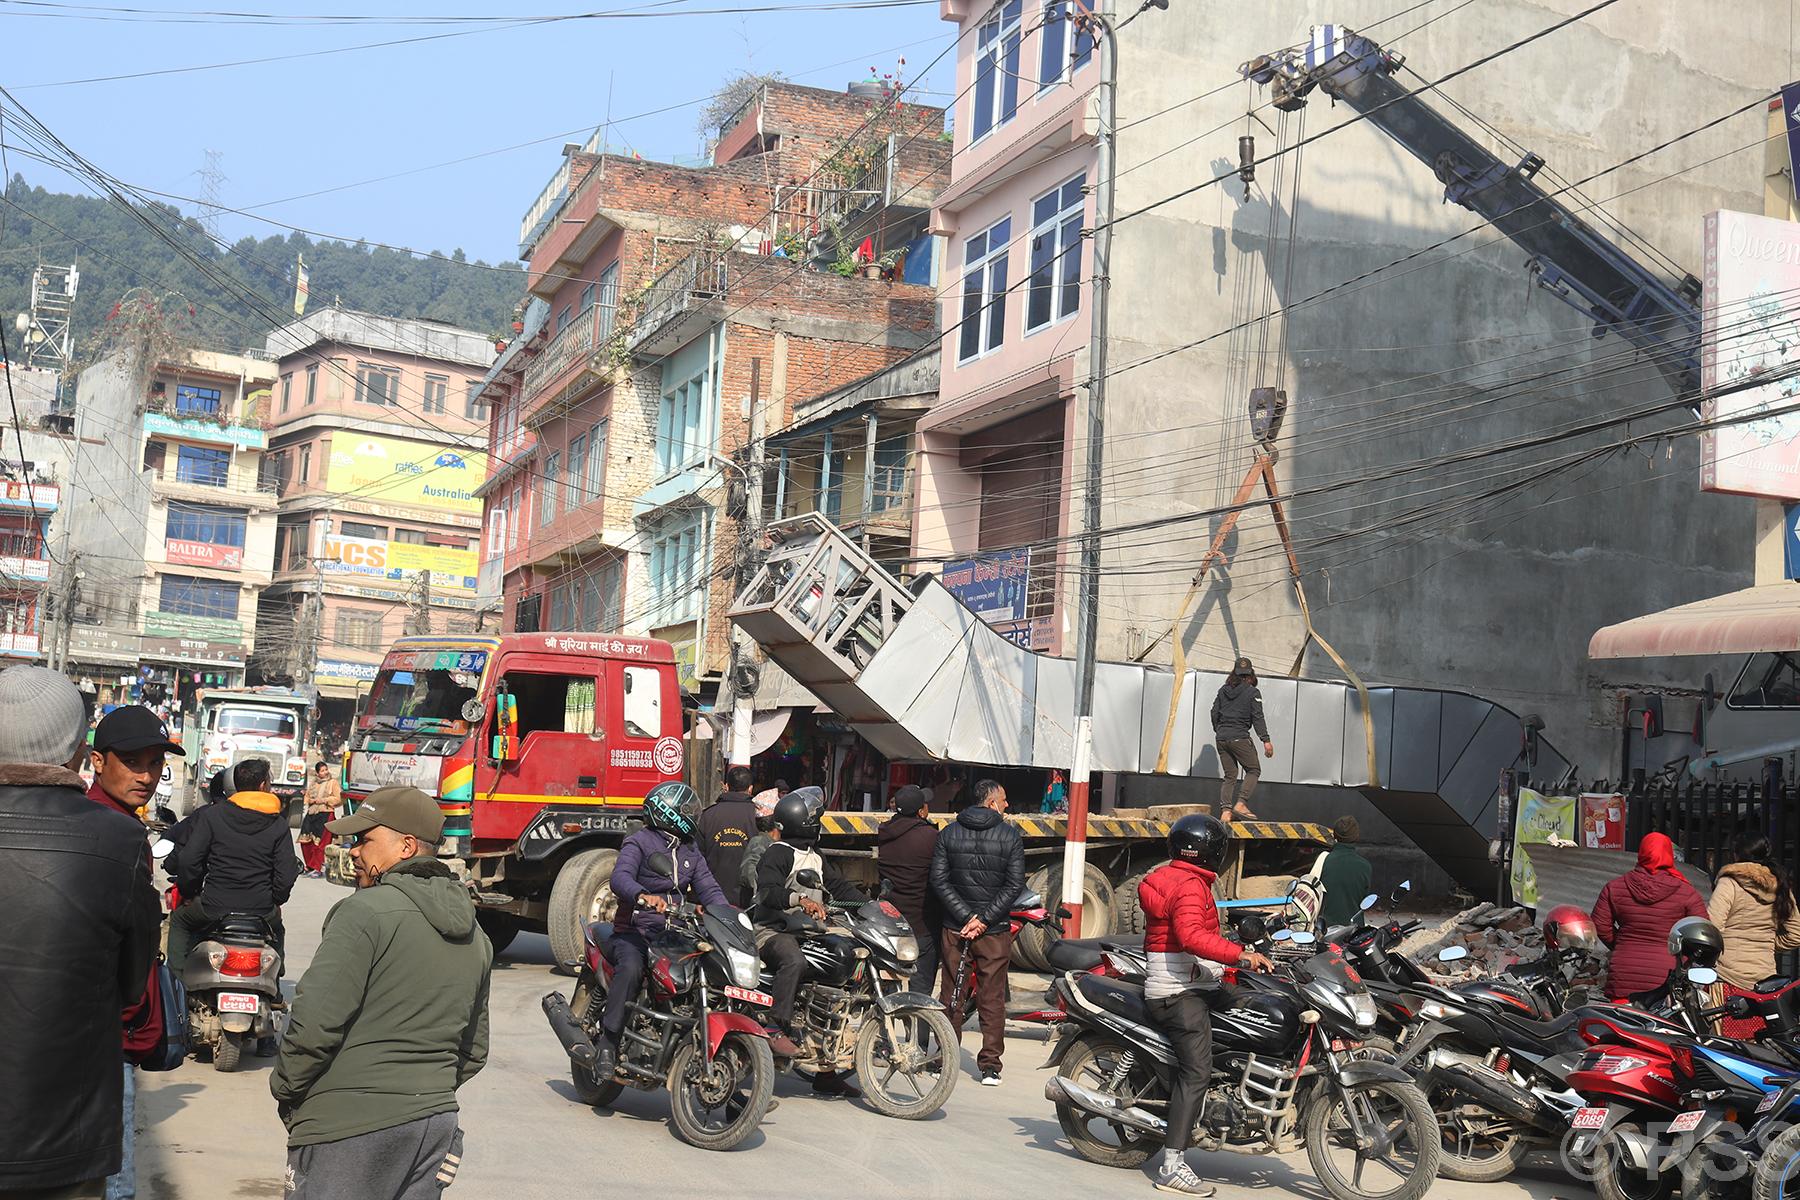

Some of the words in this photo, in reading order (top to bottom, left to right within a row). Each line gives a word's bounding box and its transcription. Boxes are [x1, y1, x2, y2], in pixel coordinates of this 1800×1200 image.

[422, 484, 472, 501] Australia
[378, 505, 447, 523] SUCCESS
[169, 542, 213, 558] BALTRA
[325, 541, 386, 568] NCS
[180, 639, 209, 650] BETTER
[649, 795, 692, 835] ADONIS
